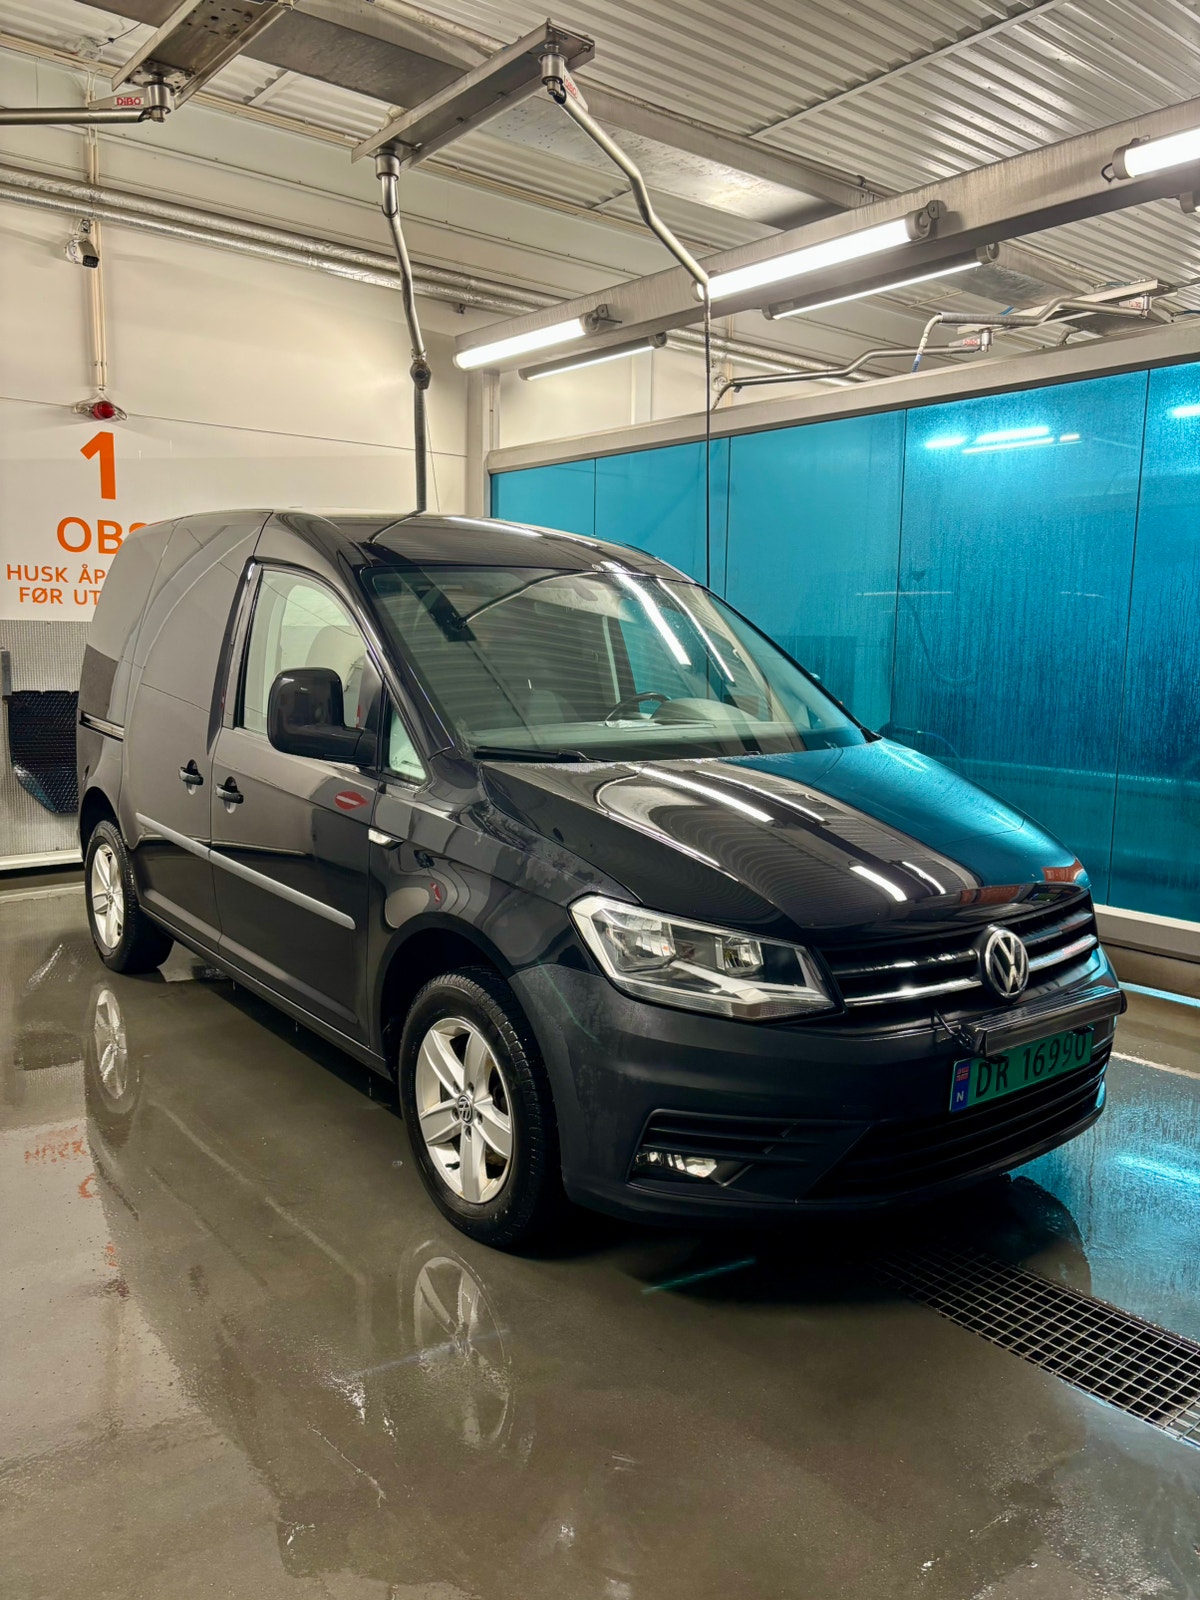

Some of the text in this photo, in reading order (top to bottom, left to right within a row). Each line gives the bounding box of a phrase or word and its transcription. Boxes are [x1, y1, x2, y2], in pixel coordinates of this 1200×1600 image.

[80, 431, 116, 500] 1
[57, 516, 148, 554] OB
[6, 563, 106, 584] HUSK ÅP
[19, 586, 102, 606] FØR UT
[975, 1032, 1087, 1098] DR 16990
[956, 1091, 964, 1103] N
